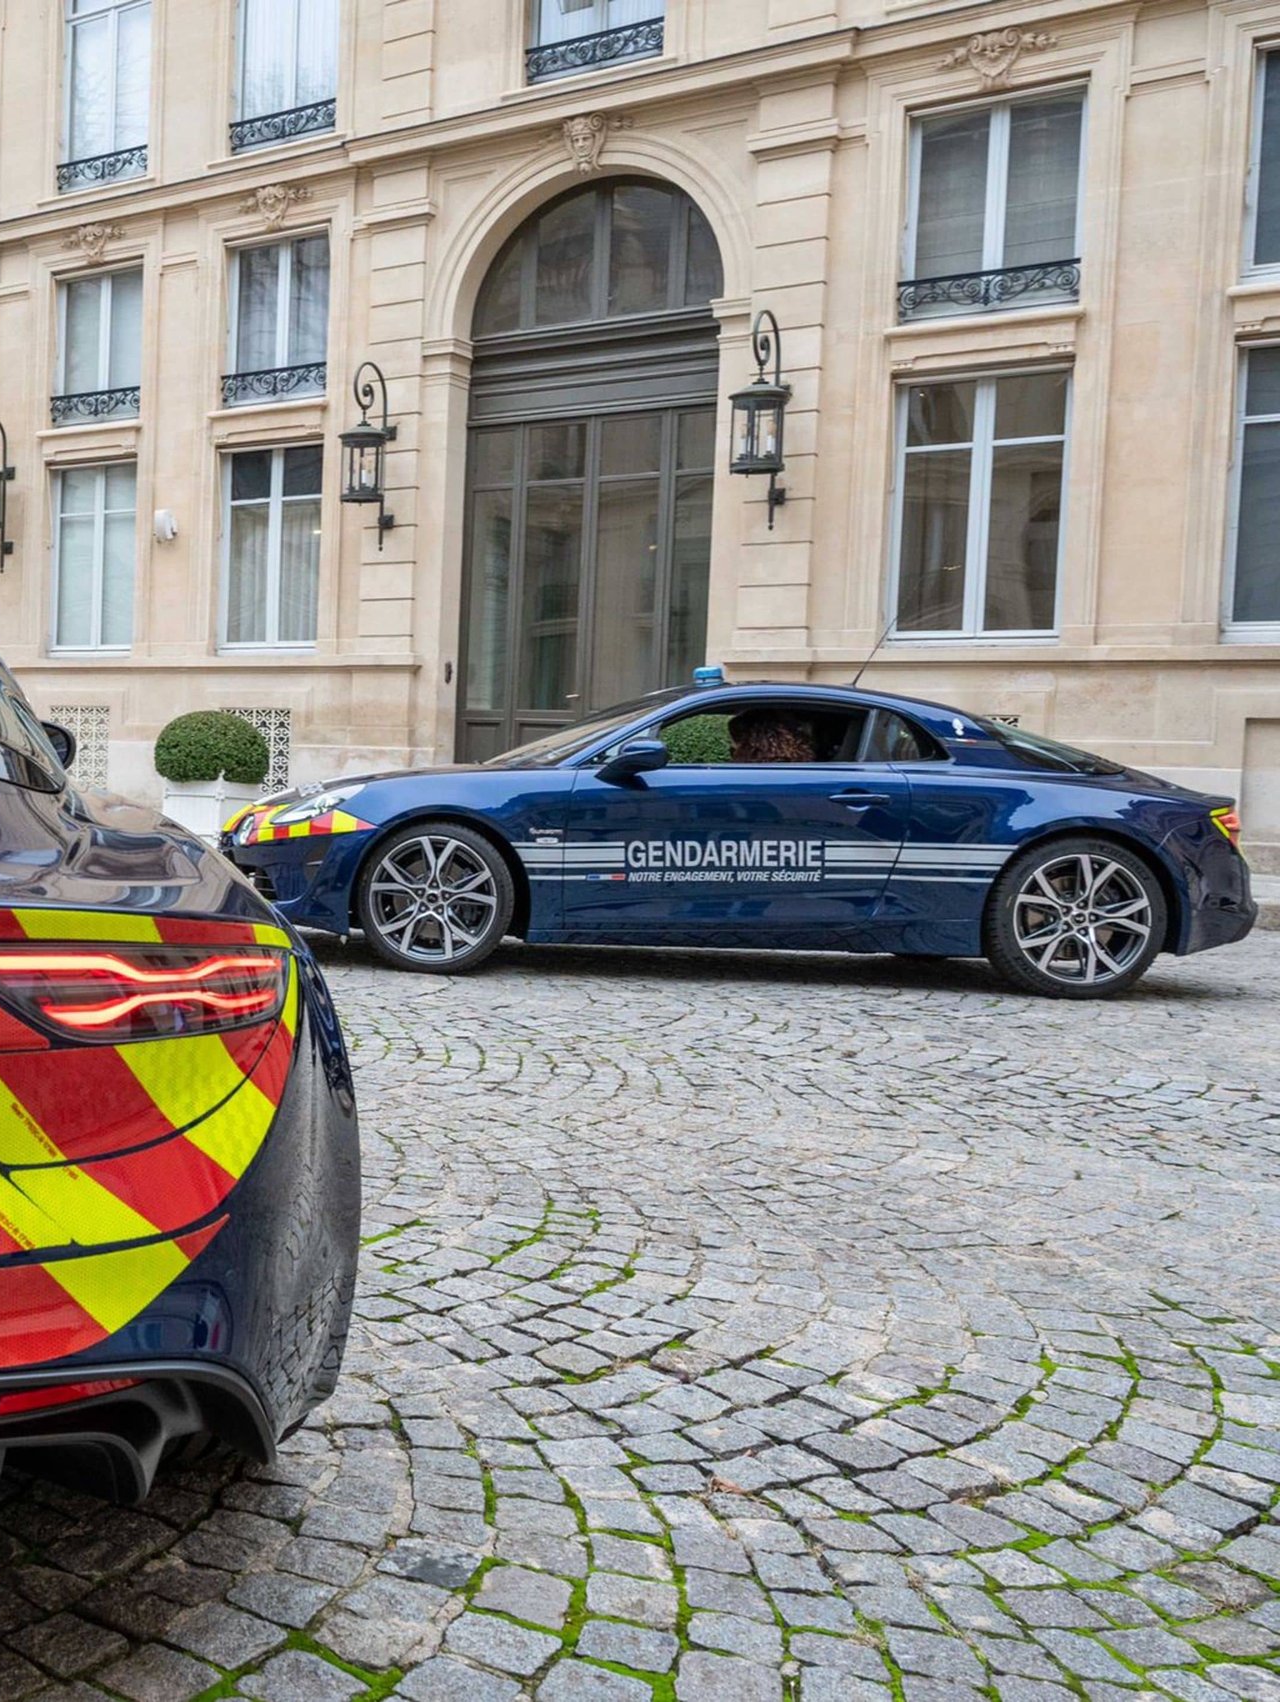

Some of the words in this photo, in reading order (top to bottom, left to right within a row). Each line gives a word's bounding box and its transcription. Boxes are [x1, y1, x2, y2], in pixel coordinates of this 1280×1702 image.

[627, 840, 822, 868] GENDARMERIE
[628, 871, 663, 882] NOTRE
[664, 871, 735, 883] ENGAGEMENT,
[736, 871, 770, 881] VOTRE
[771, 869, 822, 881] SÉCURITÉ
